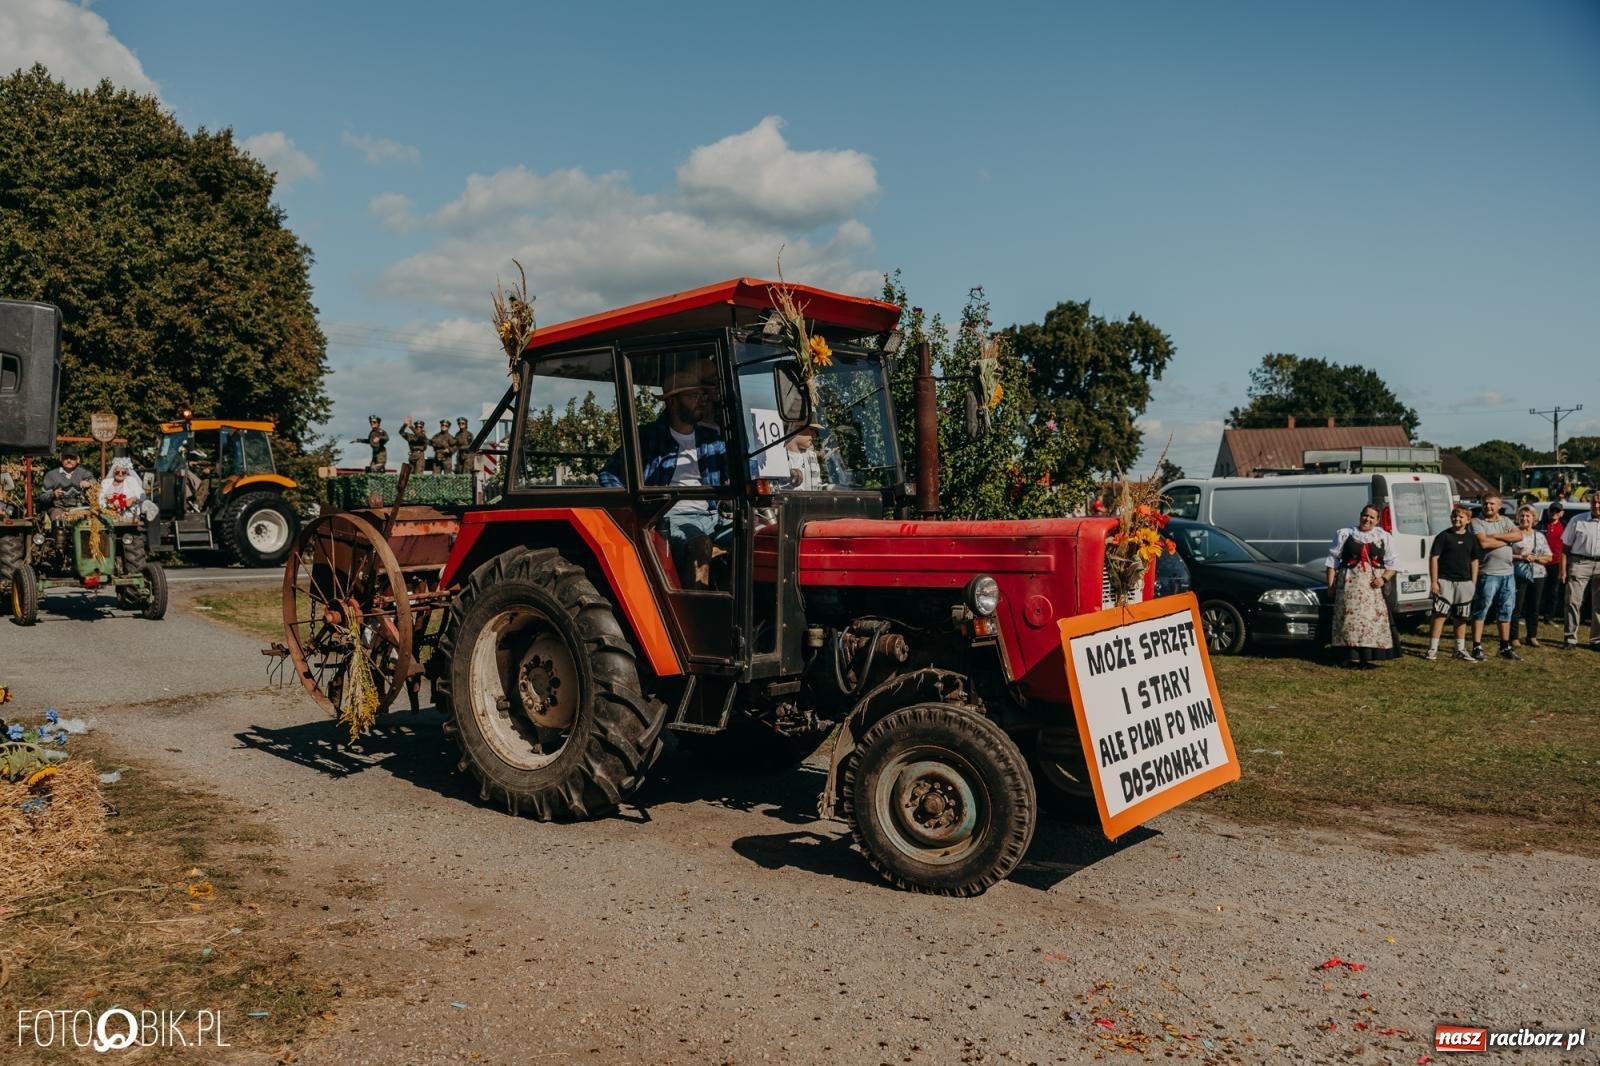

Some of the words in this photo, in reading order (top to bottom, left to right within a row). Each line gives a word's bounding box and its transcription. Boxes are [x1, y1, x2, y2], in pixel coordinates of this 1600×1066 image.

[759, 421, 780, 445] 19
[1086, 635, 1136, 676] MOŻE
[1139, 621, 1195, 660] SPRZĘT
[1121, 686, 1132, 715] I
[1137, 666, 1192, 709] STARY
[1099, 731, 1128, 768] ALE
[1127, 717, 1163, 754] PLON
[1165, 709, 1186, 739] PO
[1187, 698, 1216, 730] NIM
[1120, 738, 1210, 803] DOSKONAŁY
